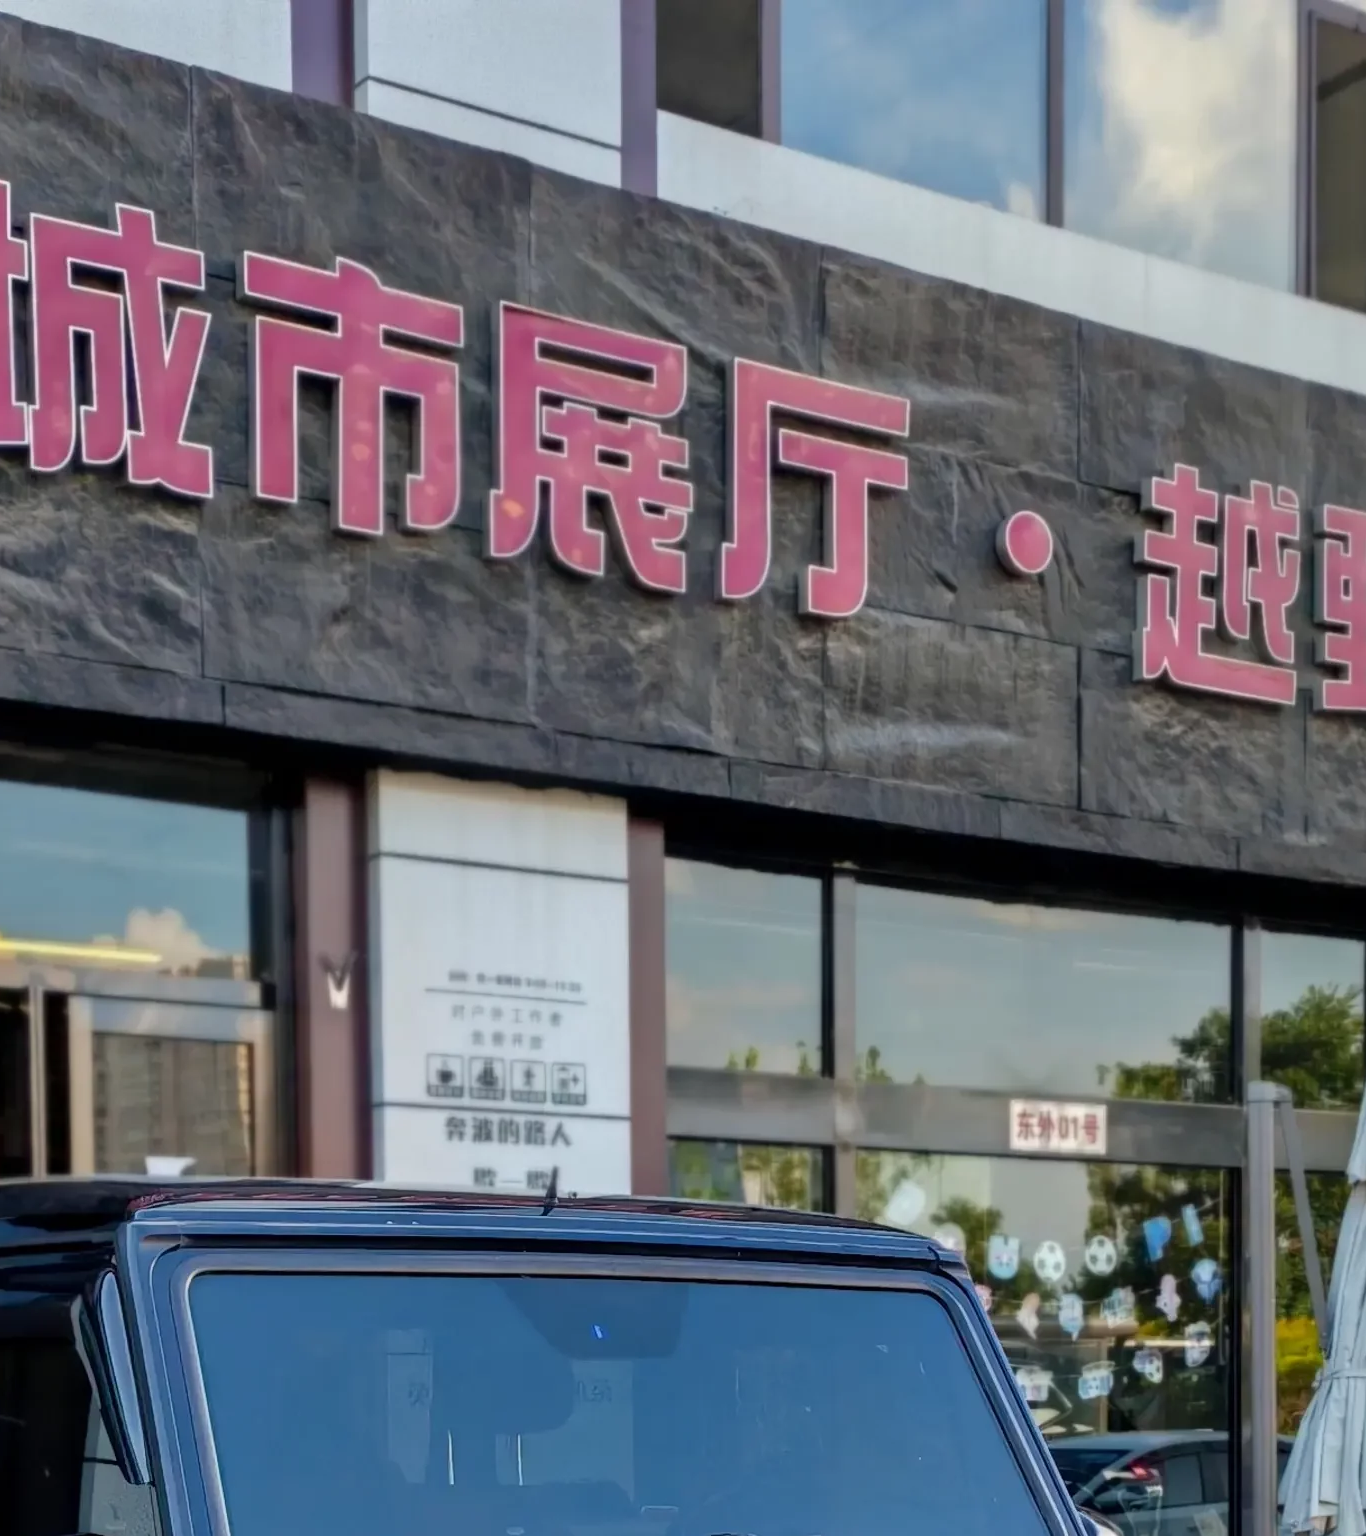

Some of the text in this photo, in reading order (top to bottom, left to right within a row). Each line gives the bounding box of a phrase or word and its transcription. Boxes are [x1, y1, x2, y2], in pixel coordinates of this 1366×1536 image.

[444, 1115, 572, 1148] 奔波的路人
[1016, 1108, 1100, 1144] 东外01号
